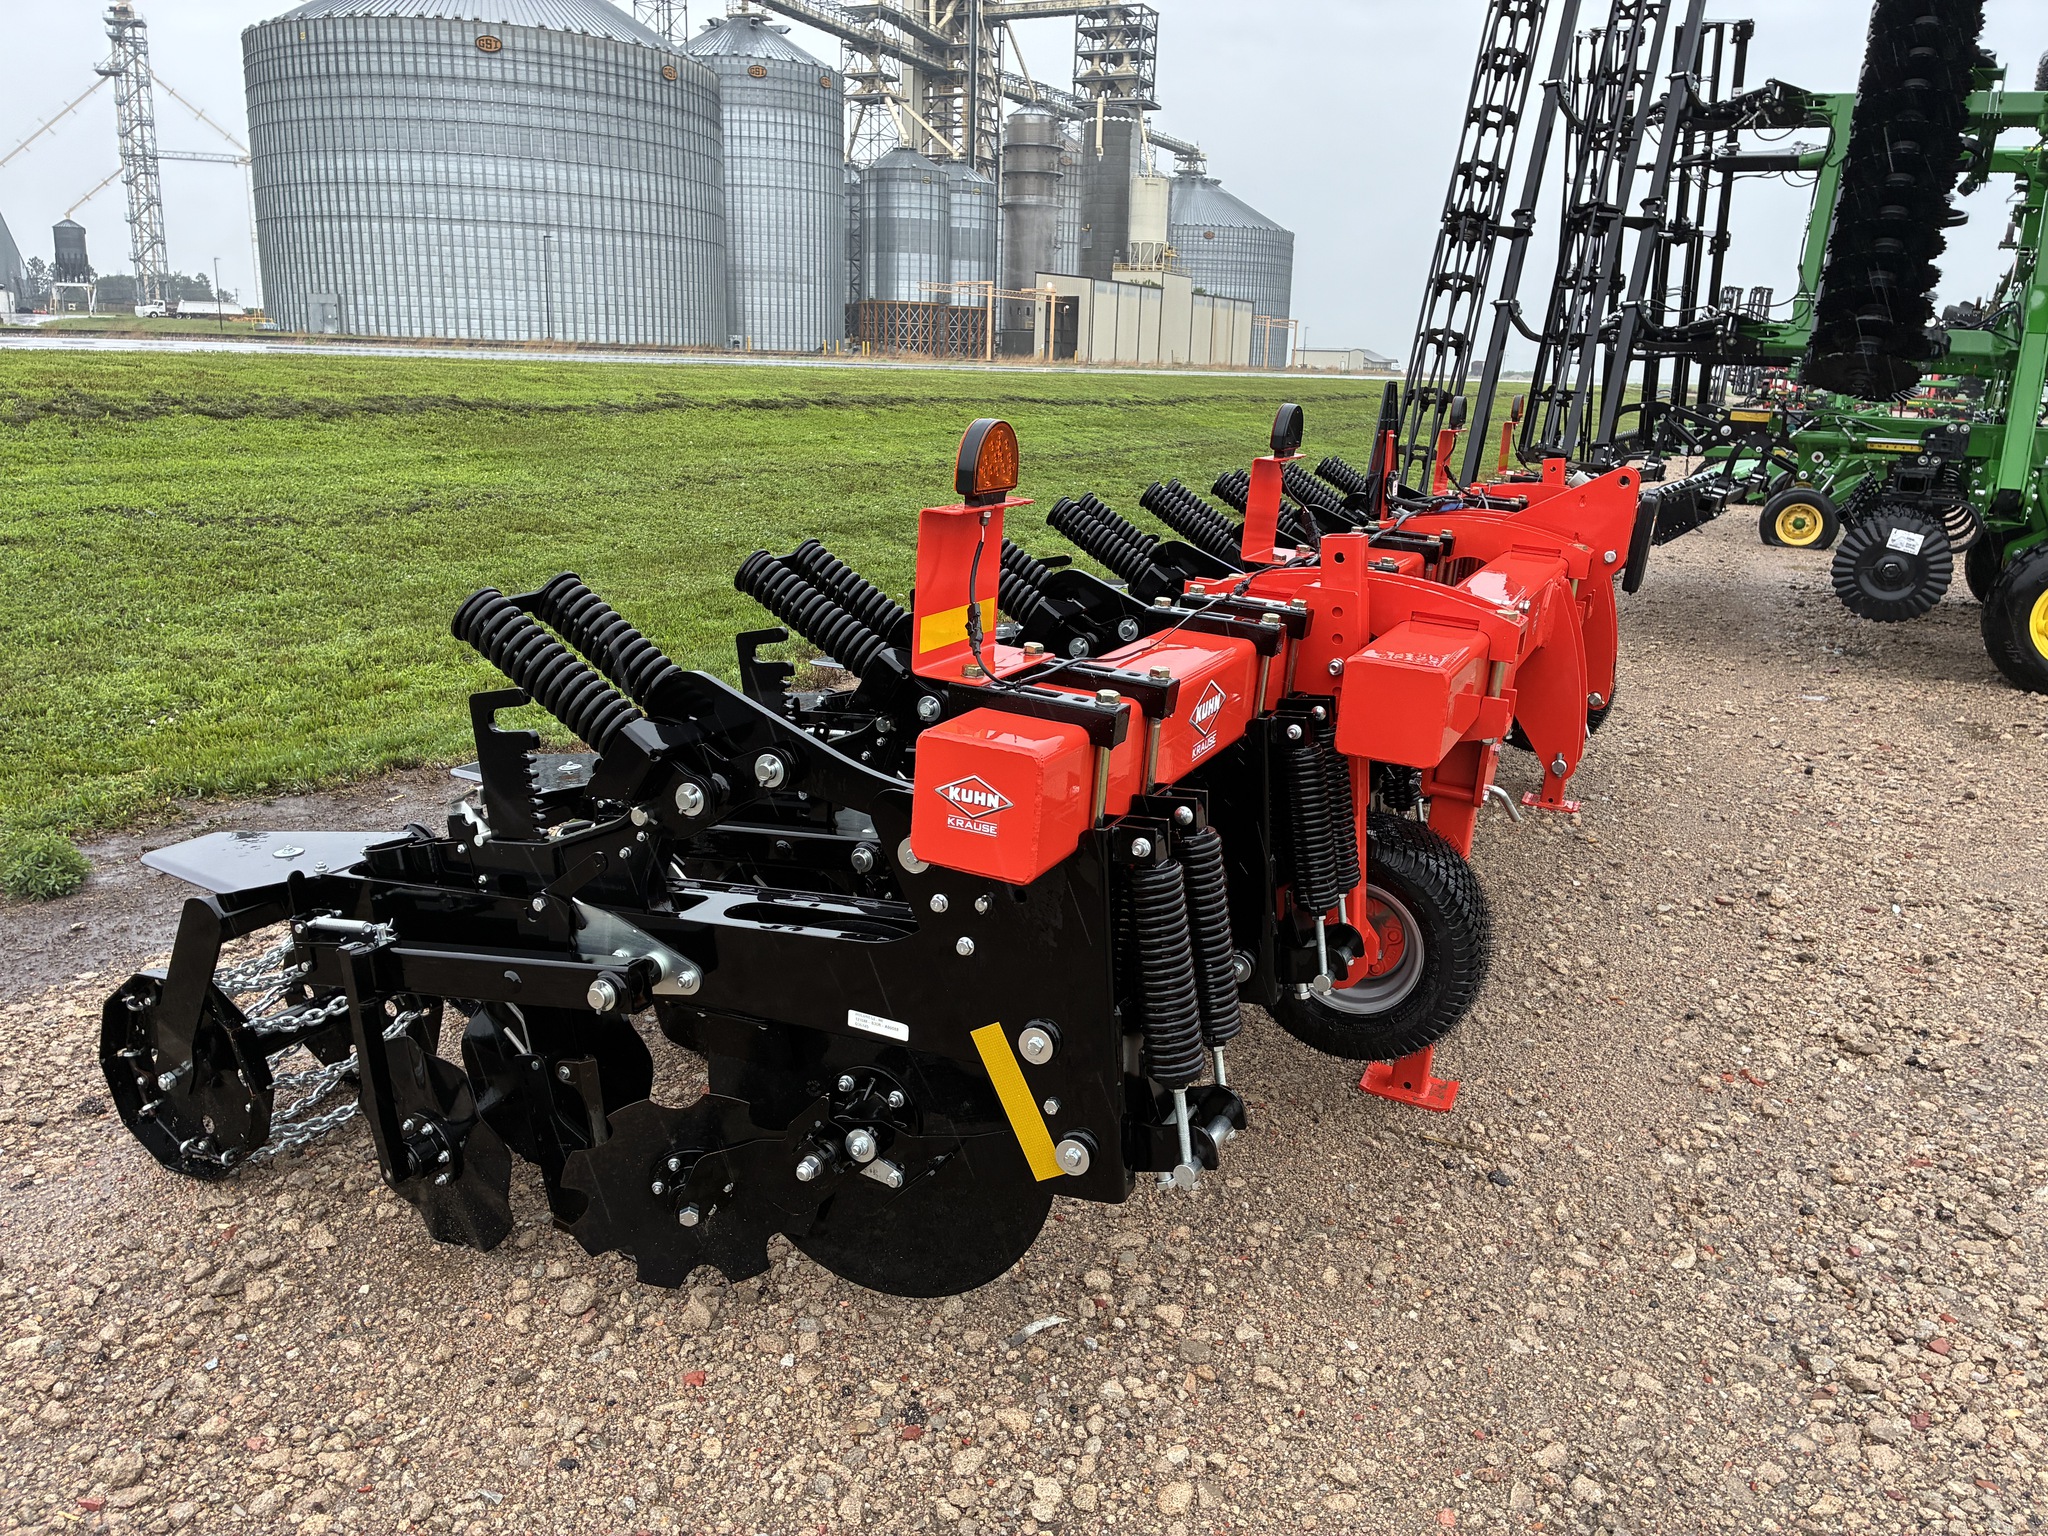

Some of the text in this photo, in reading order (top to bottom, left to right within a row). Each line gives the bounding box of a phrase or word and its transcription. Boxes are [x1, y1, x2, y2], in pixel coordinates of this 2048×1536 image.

[478, 38, 499, 50] GSI
[749, 67, 765, 76] GSI
[1195, 692, 1221, 724] KUHN
[1192, 733, 1217, 759] KRAUSE
[948, 785, 1000, 809] KUHN
[947, 817, 998, 835] KRAUSE
